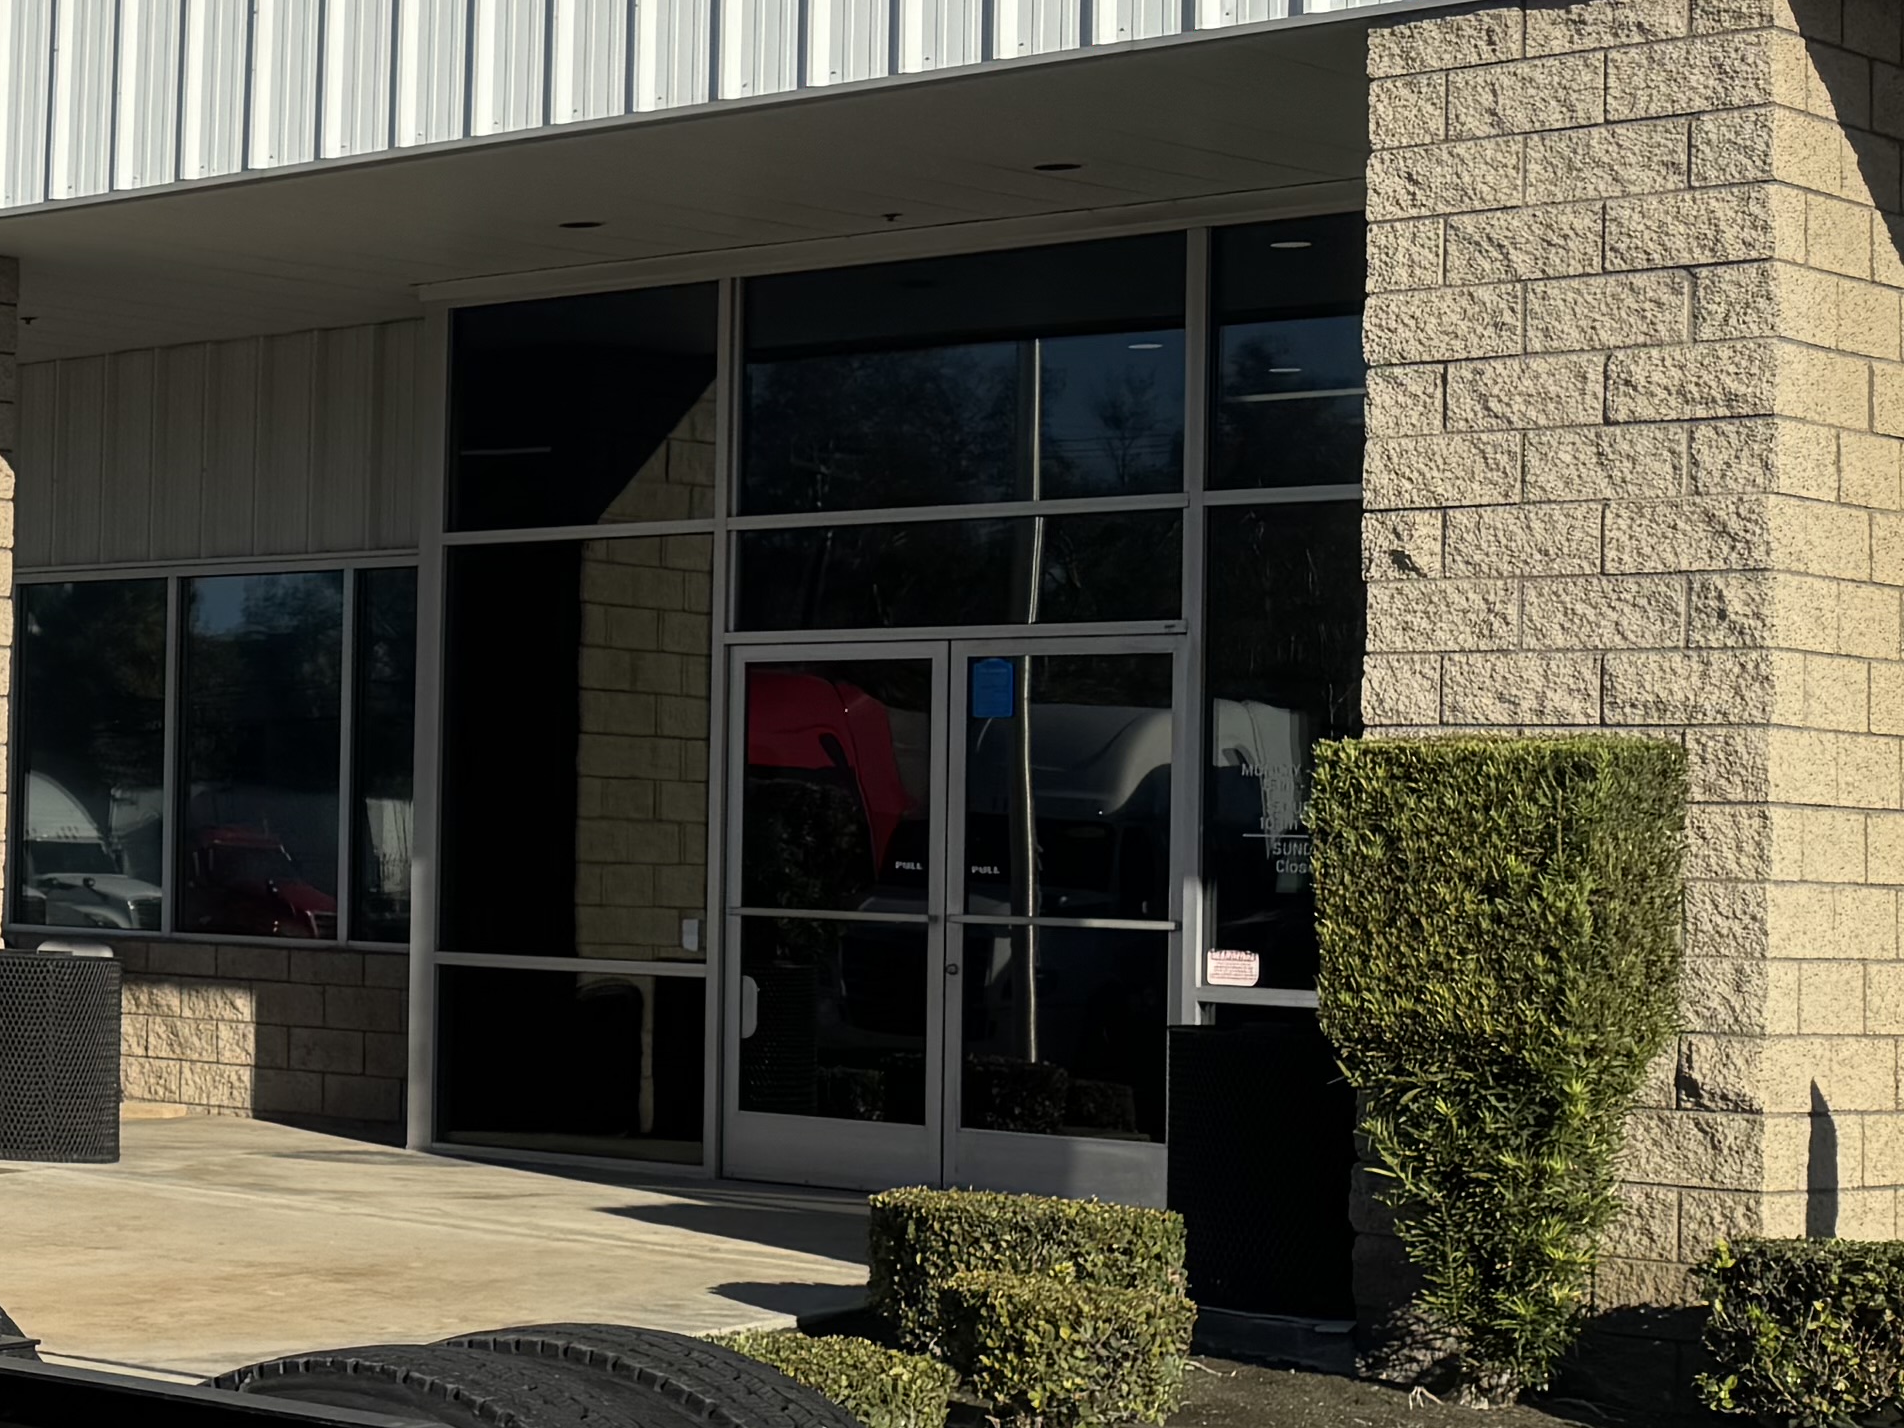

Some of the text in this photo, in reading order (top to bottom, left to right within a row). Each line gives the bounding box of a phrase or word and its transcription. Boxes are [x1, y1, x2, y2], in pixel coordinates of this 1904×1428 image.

[1272, 842, 1312, 856] SUND
[895, 861, 923, 870] PULL
[971, 866, 1000, 874] PULL
[1275, 858, 1310, 874] Clos
